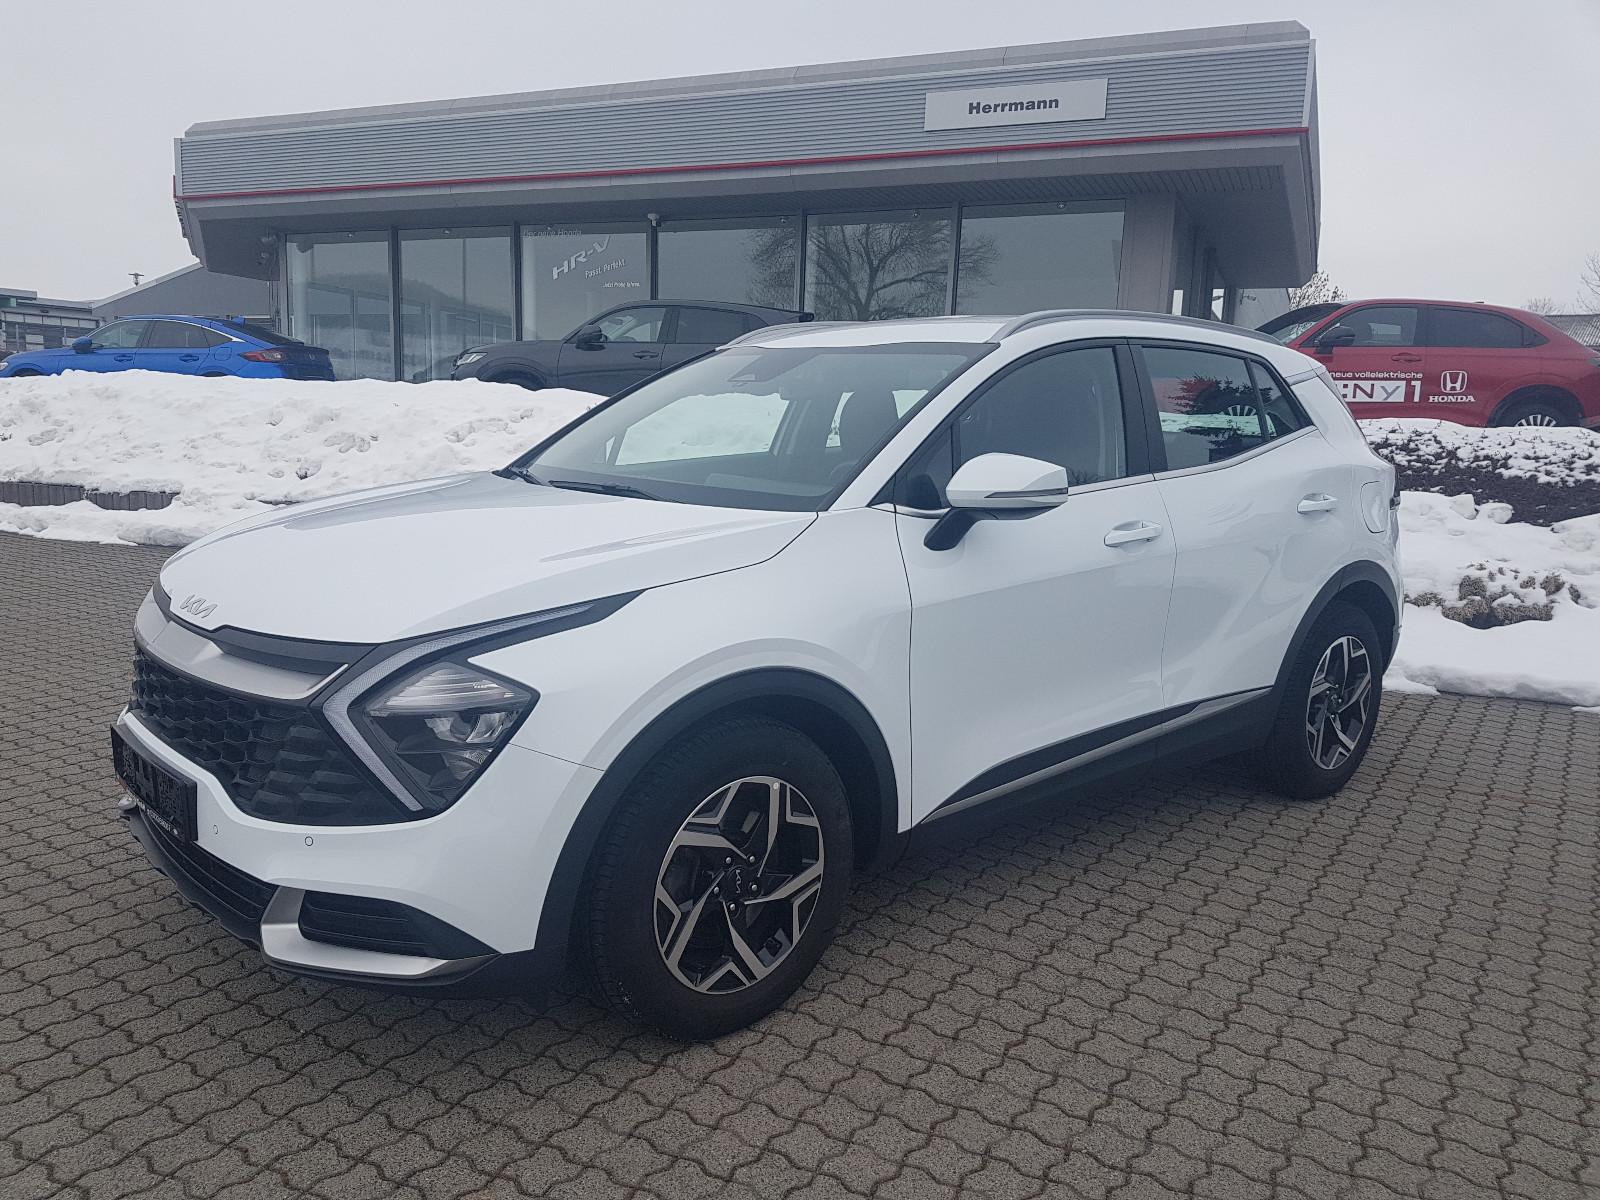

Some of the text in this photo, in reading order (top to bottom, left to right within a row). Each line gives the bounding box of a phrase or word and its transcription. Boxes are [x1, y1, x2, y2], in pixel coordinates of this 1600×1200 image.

[968, 98, 1059, 114] Herrmann
[552, 235, 611, 280] HR-V
[1354, 370, 1423, 379] vollelektrische
[1428, 395, 1476, 403] HONDA
[180, 594, 218, 618] KIA
